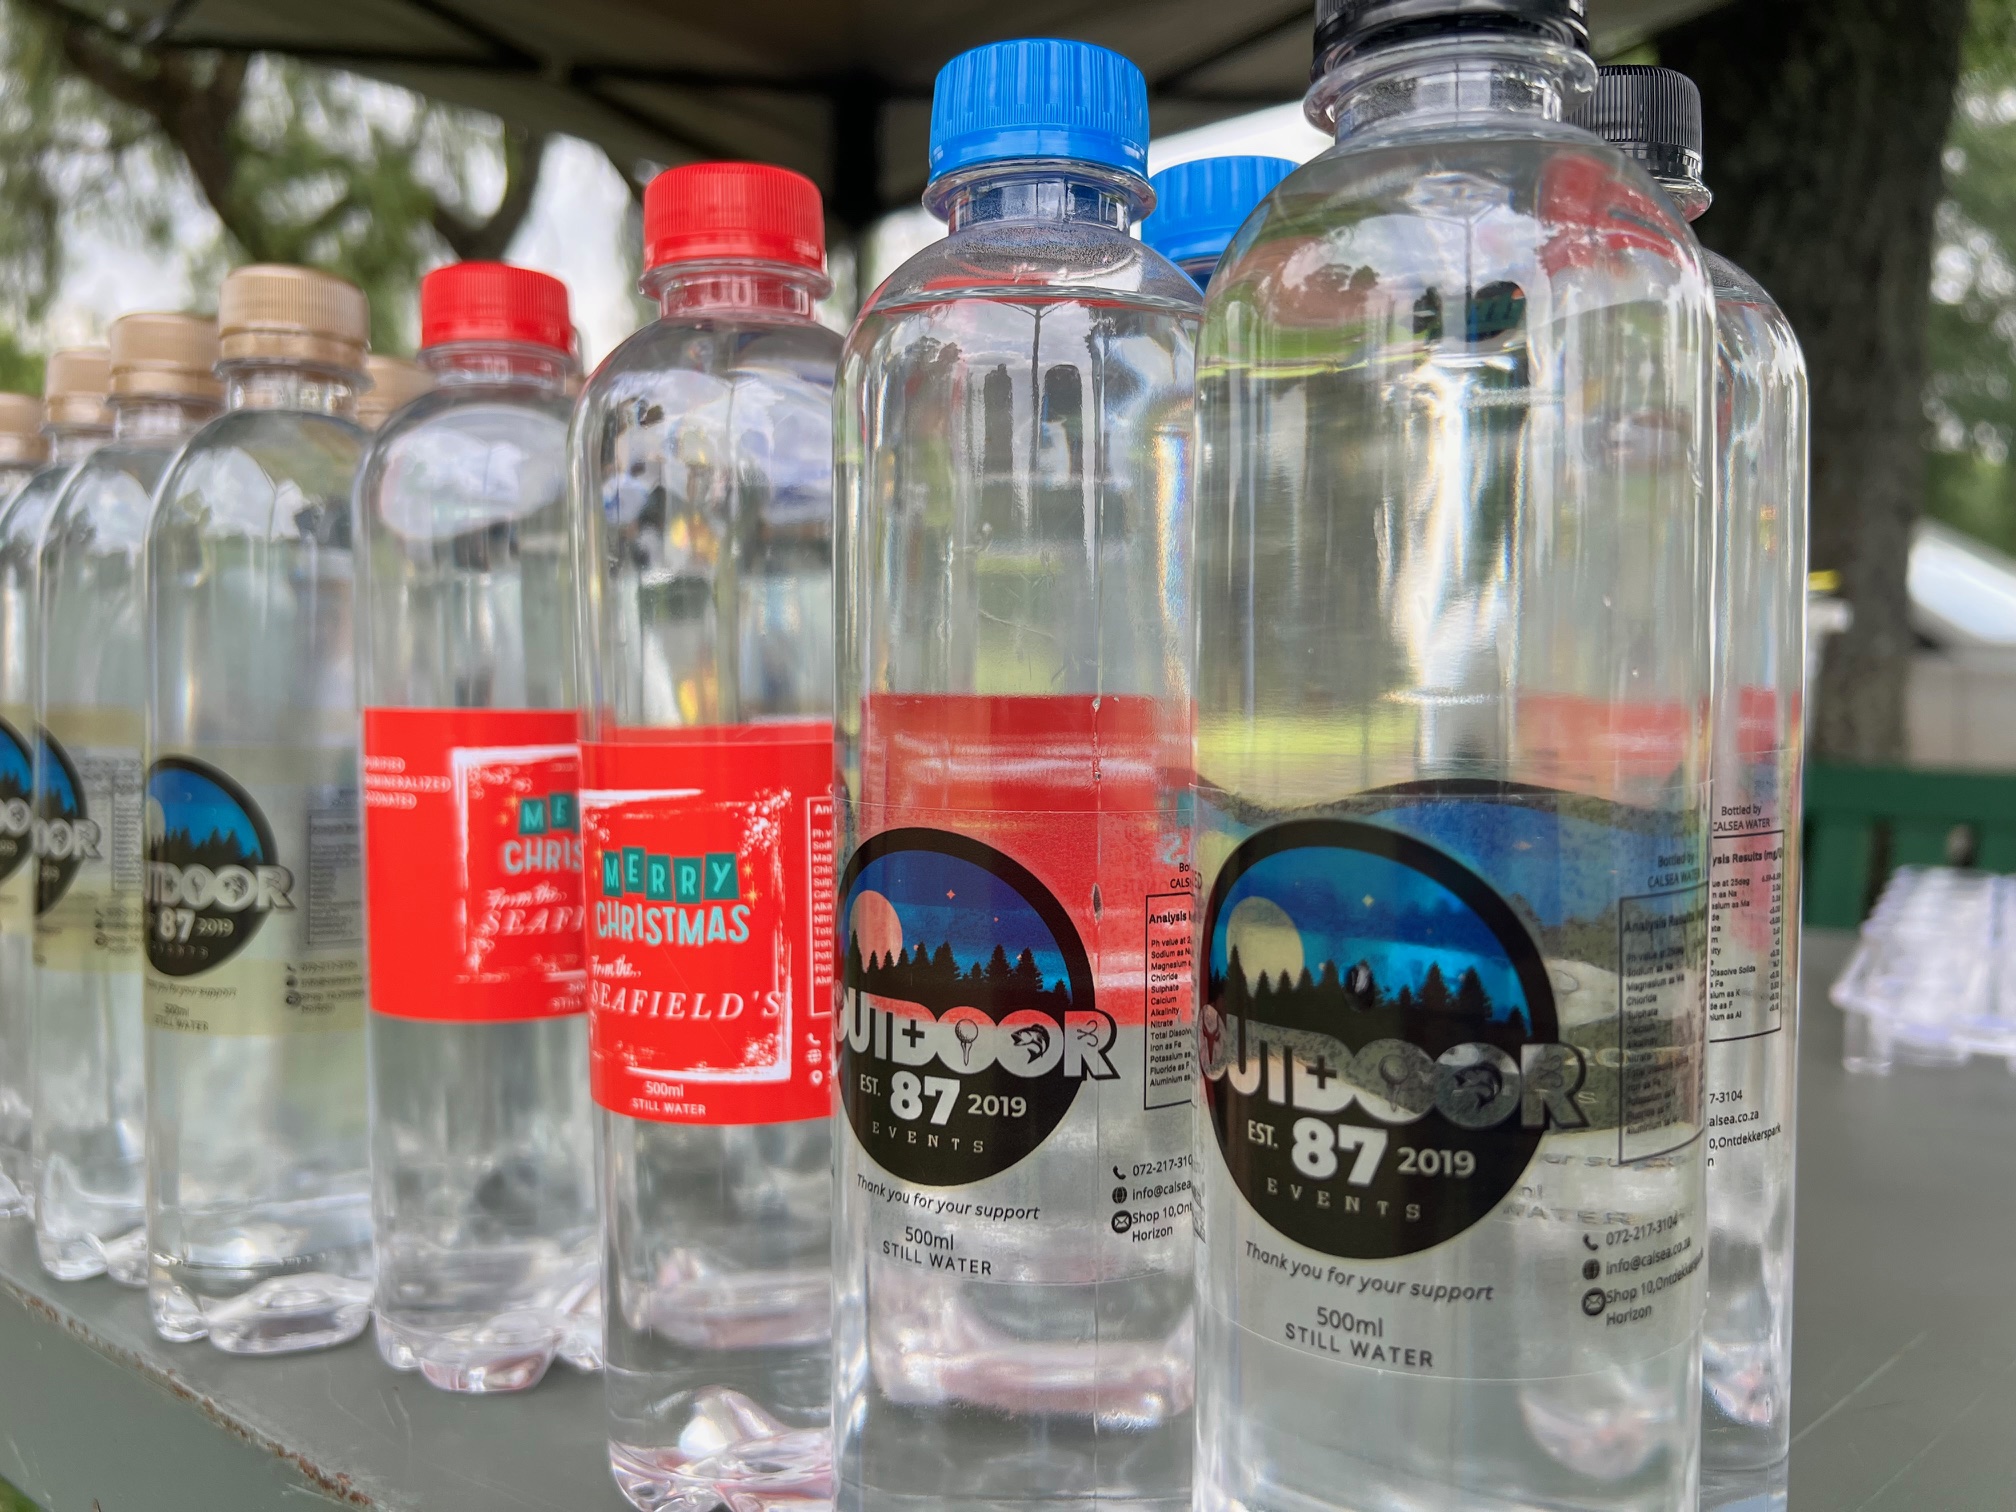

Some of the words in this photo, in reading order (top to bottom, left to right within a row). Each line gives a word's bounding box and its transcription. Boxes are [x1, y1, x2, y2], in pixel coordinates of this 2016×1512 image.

[1721, 805, 1751, 816] Bottled
[1752, 804, 1762, 816] by
[1745, 818, 1771, 830] WATER
[1732, 851, 1763, 863] Results
[604, 852, 732, 896] MERRY
[1647, 872, 1679, 888] CALSEA
[1730, 878, 1750, 888] 25deg
[1728, 890, 1737, 898] Na
[160, 907, 196, 943] 87
[596, 901, 751, 946] CHRISTMAS
[1149, 911, 1187, 925] Analysis
[1151, 939, 1160, 947] Ph
[1161, 939, 1178, 947] value
[1180, 937, 1186, 945] at
[1151, 950, 1175, 959] Sodium
[1151, 960, 1187, 972] Magnesium
[1710, 968, 1737, 977] Dissolve
[1739, 965, 1756, 974] Solids
[1151, 972, 1178, 982] Chloride
[1151, 984, 1179, 994] Sulphate
[591, 979, 780, 1021] SEAFIELD'S
[1151, 996, 1177, 1005] Calcium
[1626, 994, 1657, 1006] Chloride
[1151, 1007, 1179, 1017] Alkalinity
[834, 986, 1121, 1080] OUTDOOR
[1151, 1020, 1173, 1029] Nitrate
[1151, 1031, 1167, 1040] Total
[1150, 1044, 1163, 1052] Iron
[1150, 1052, 1183, 1063] Potassium
[1150, 1064, 1176, 1075] Fluoride
[1198, 1004, 1588, 1130] OUTDOOR
[645, 1081, 684, 1098] 500ml
[860, 1073, 881, 1097] EST.
[1150, 1075, 1182, 1087] Aluminium
[890, 1070, 961, 1125] 87
[1709, 1089, 1743, 1104] 7-3104
[632, 1098, 660, 1112] STILL
[663, 1102, 706, 1116] WATER
[967, 1093, 1027, 1118] 2019
[872, 1121, 985, 1153] EVENTS
[1247, 1119, 1278, 1149] EST.
[1291, 1117, 1388, 1187] 87
[1132, 1154, 1193, 1177] 072-217-310
[1397, 1147, 1476, 1177] 2019
[857, 1173, 886, 1197] Thank
[887, 1189, 910, 1204] you
[913, 1192, 934, 1209] for
[935, 1199, 972, 1215] your
[975, 1204, 1041, 1222] support
[1266, 1177, 1421, 1221] EVENTS
[1132, 1211, 1160, 1225] Shop
[1132, 1226, 1173, 1243] Horizon
[1605, 1210, 1678, 1246] 072-217-3104
[905, 1226, 954, 1250] 500ml
[883, 1240, 922, 1264] STILL
[929, 1252, 992, 1275] WATER
[1245, 1240, 1288, 1271] Thank
[1290, 1261, 1322, 1279] you
[1327, 1266, 1355, 1286] for
[1357, 1276, 1406, 1295] your
[1410, 1282, 1495, 1303] support
[1606, 1287, 1637, 1304] Shop
[1316, 1306, 1383, 1338] 500ml
[1606, 1304, 1652, 1326] Horizon
[1284, 1322, 1340, 1353] STILL
[1350, 1339, 1434, 1368] WATER
